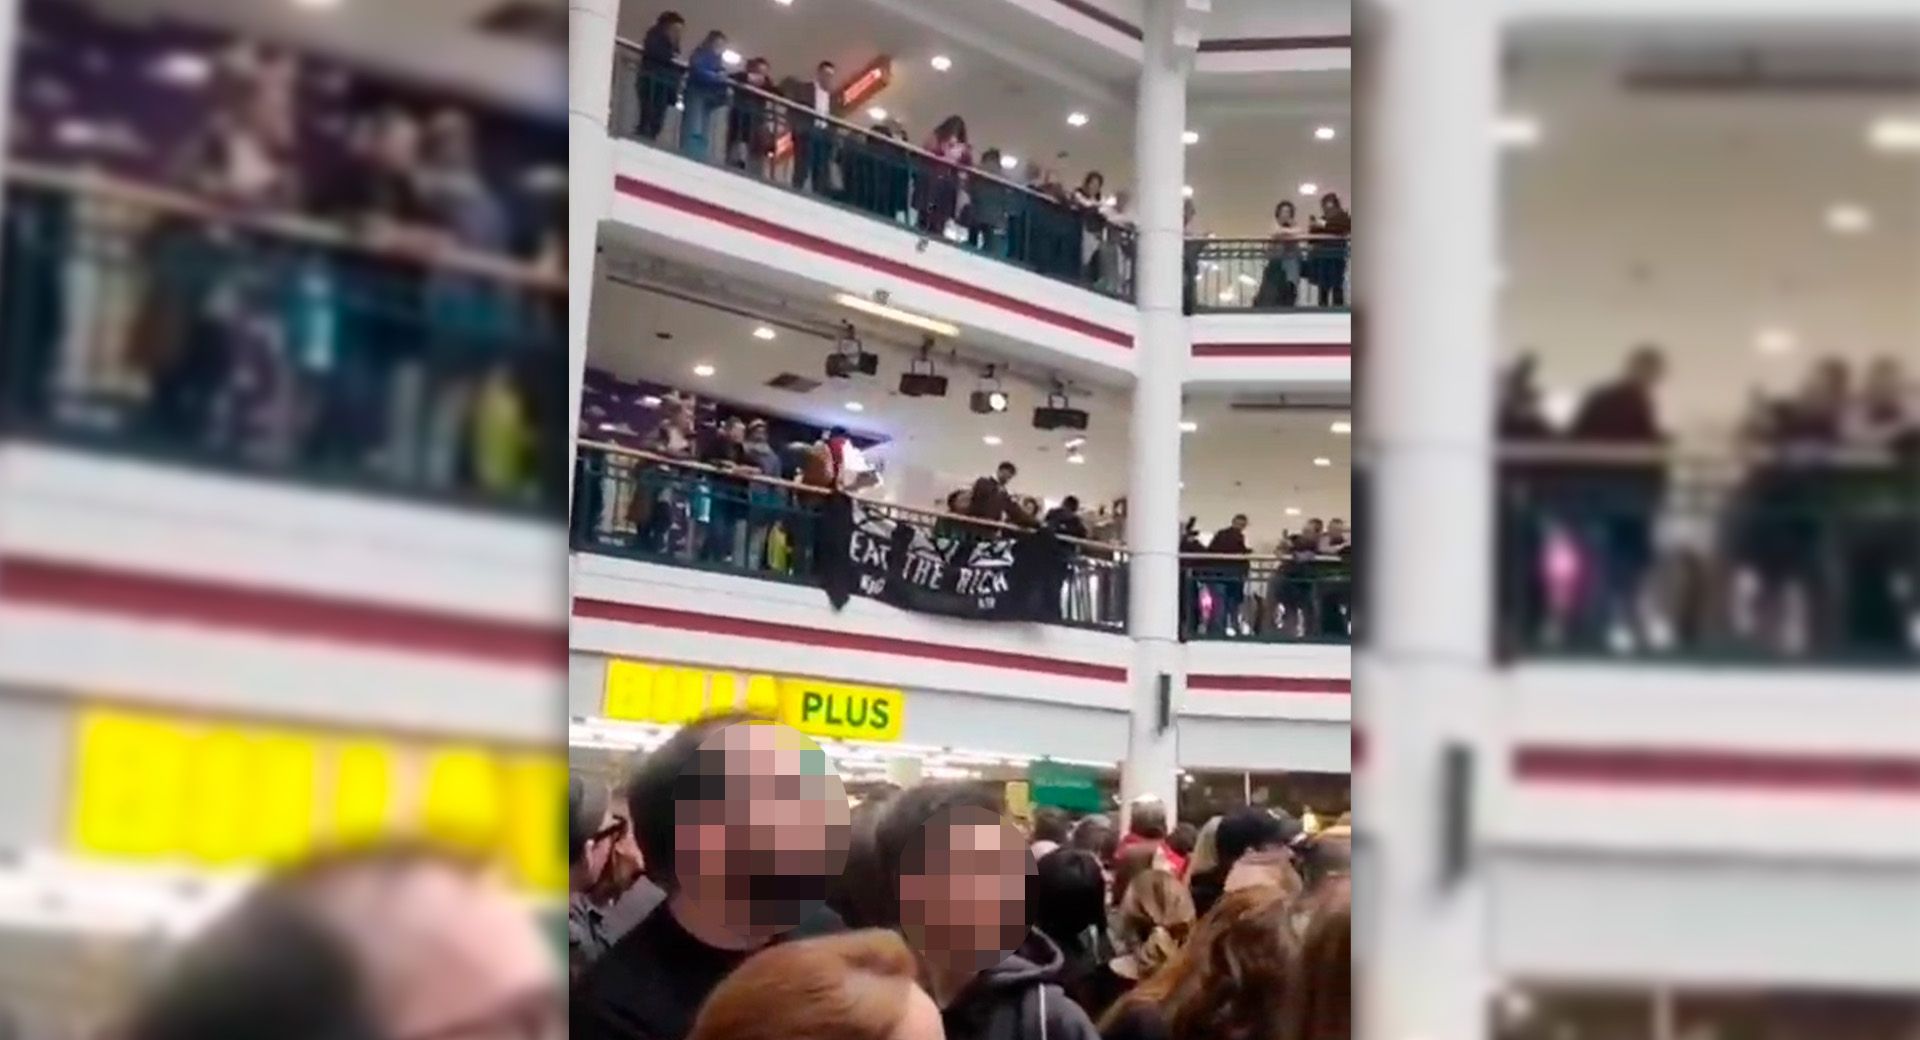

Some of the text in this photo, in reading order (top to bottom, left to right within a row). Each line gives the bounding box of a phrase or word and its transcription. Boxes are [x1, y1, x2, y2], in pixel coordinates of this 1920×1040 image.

[850, 531, 892, 570] EAT
[902, 552, 945, 590] THE
[956, 568, 1009, 595] RICH
[801, 691, 890, 729] PLUS
